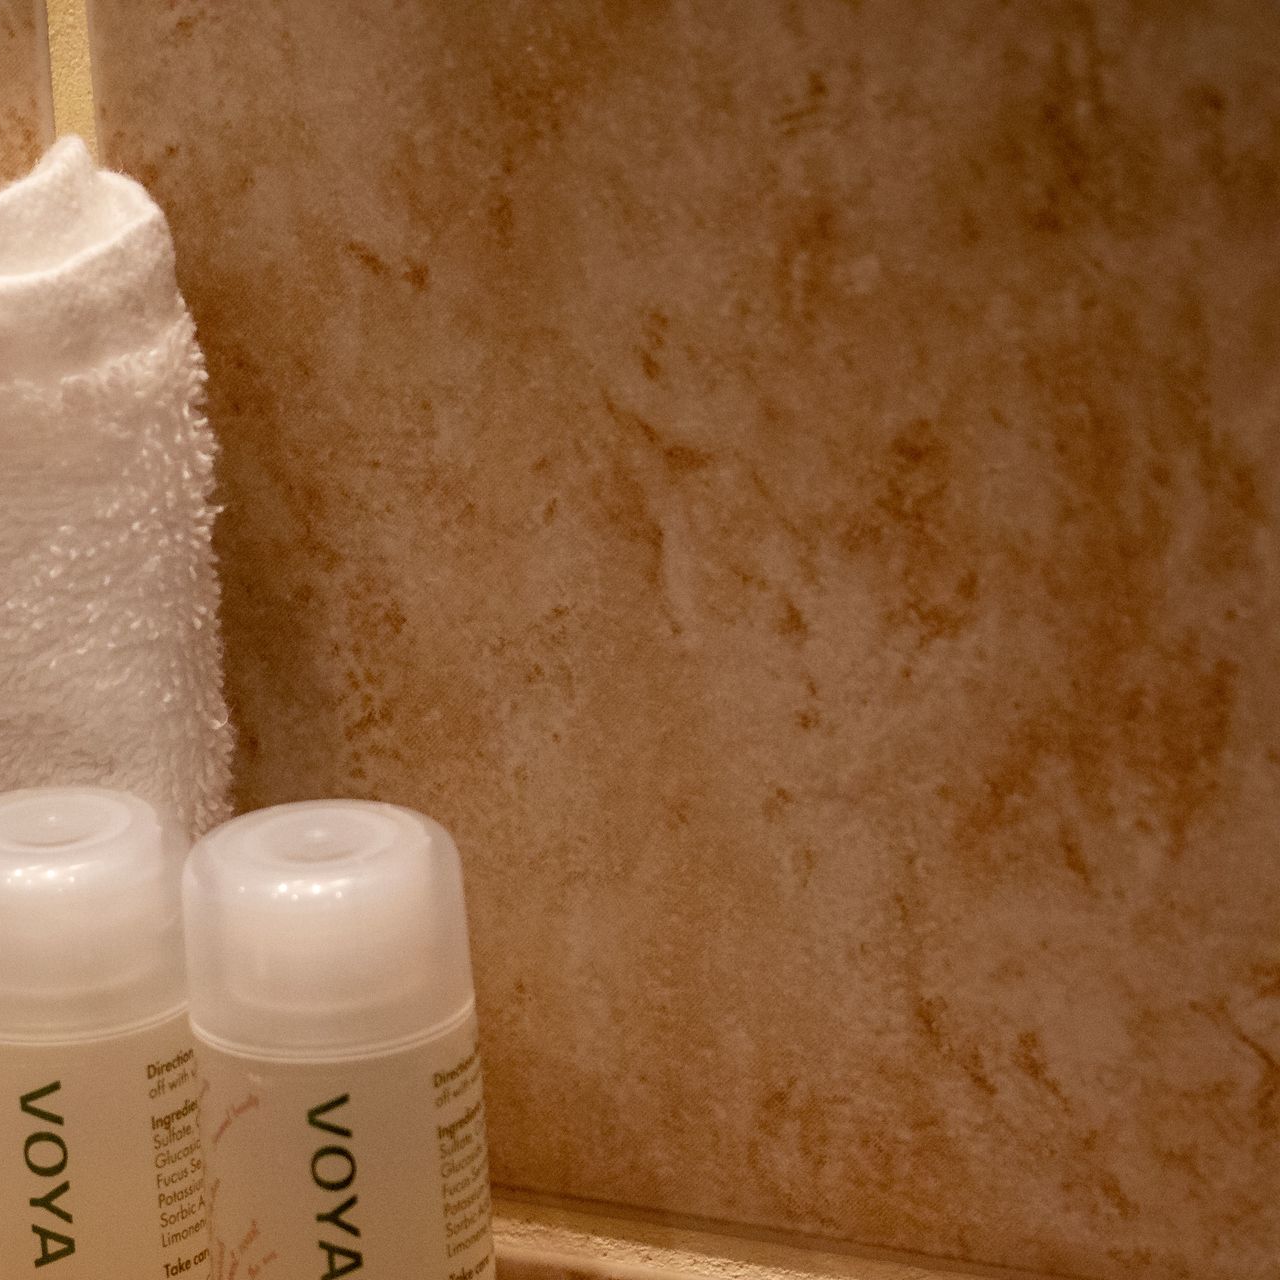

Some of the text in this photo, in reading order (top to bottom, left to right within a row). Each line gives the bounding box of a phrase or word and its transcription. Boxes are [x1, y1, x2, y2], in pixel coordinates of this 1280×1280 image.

[20, 1080, 76, 1269] VOYA
[157, 1168, 189, 1190] Fucus
[160, 1203, 196, 1229] Sorbic
[164, 1256, 191, 1279] Take
